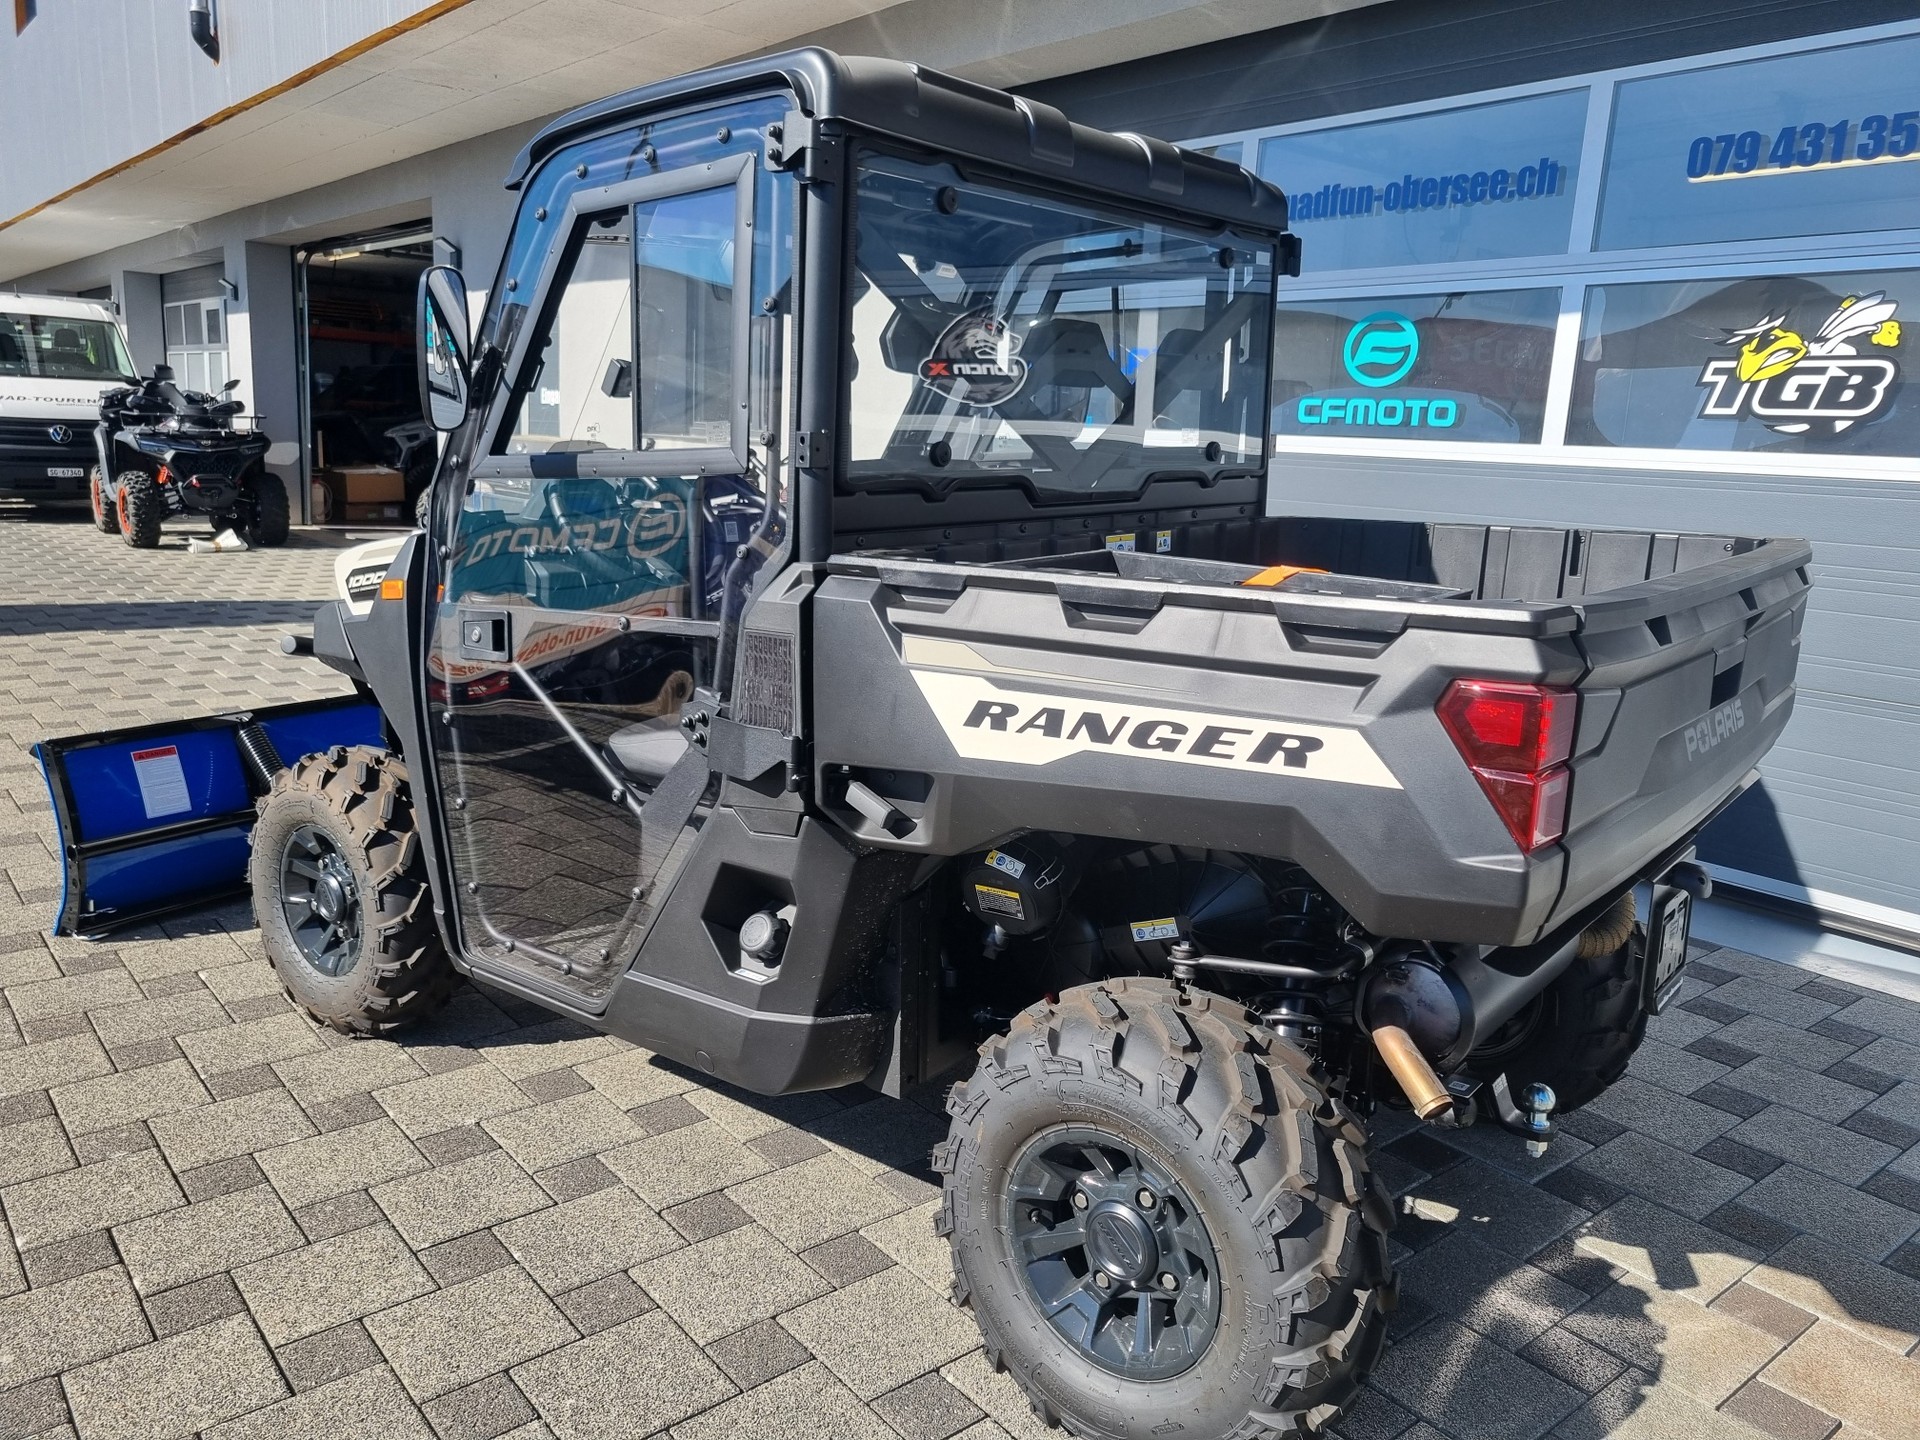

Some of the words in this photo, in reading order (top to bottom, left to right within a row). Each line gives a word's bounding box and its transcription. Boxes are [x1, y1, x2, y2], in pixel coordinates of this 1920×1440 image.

[1686, 130, 1762, 178] 079
[1768, 119, 1849, 169] 431
[1856, 110, 1920, 161] 35
[1287, 156, 1560, 221] uadfun-obersee.ch
[1298, 397, 1457, 427] CFMOTO
[1699, 357, 1898, 419] TGB
[963, 699, 1325, 759] RANGER
[1684, 698, 1745, 762] POLARIS
